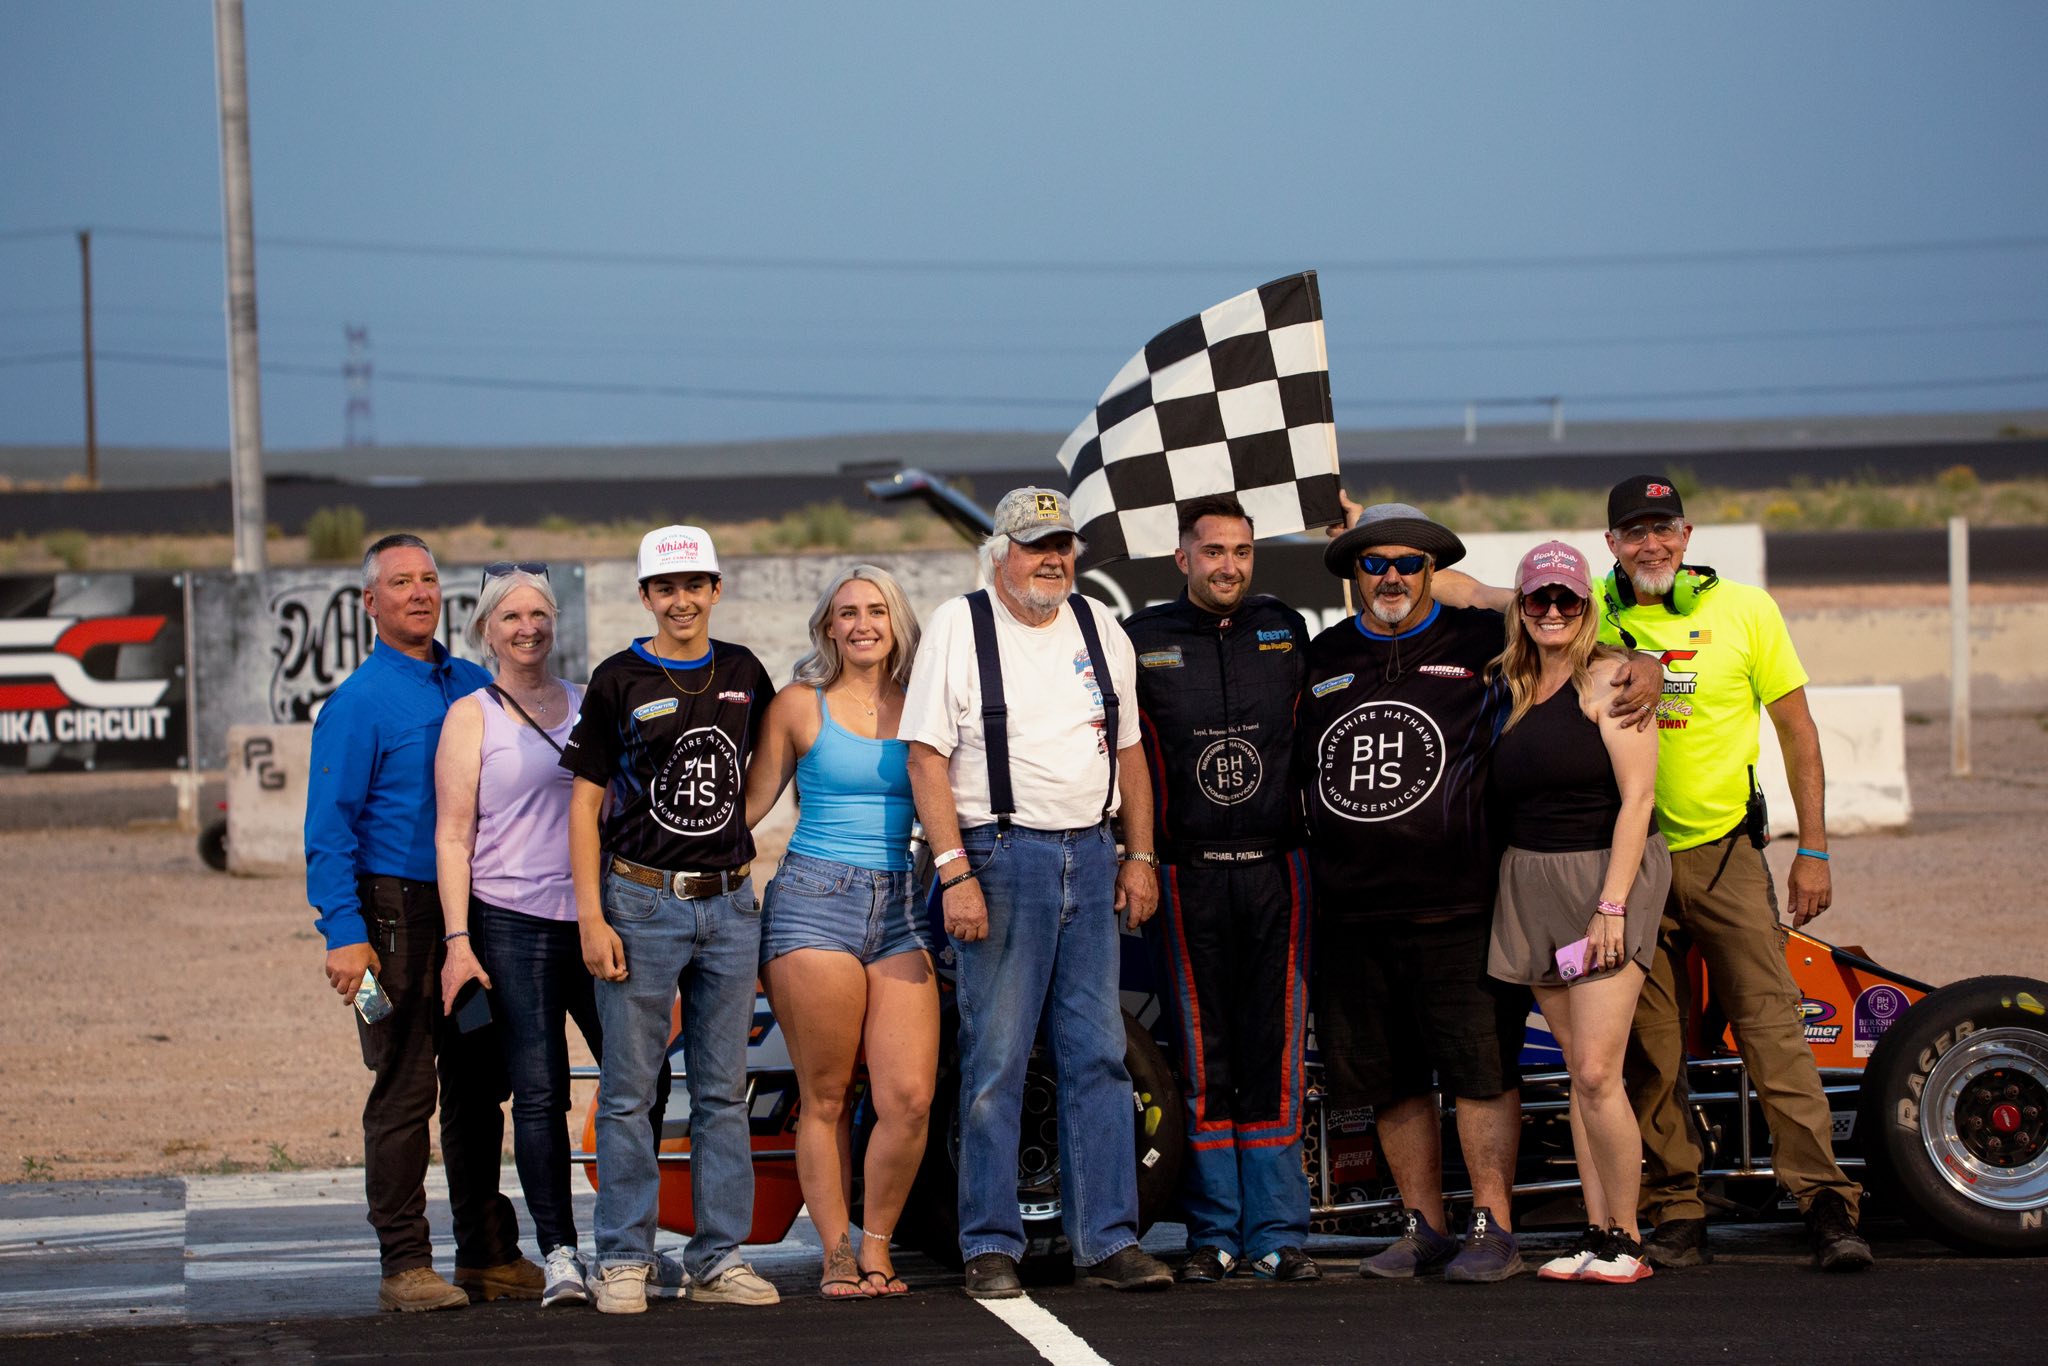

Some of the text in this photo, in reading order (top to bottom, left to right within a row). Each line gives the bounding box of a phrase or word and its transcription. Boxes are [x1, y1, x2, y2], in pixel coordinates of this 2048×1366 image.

[656, 540, 698, 554] Whiskey
[1419, 665, 1466, 674] RADICAL
[1663, 682, 1696, 693] IRCUIT
[54, 708, 171, 742] CIRCUIT
[1325, 710, 1435, 769] BERKSHIRE HATHAWAY
[1352, 731, 1403, 762] BH
[660, 737, 701, 791] BERKSHIRE
[1201, 741, 1258, 771] BERKSHIRE HATHAWAY
[1216, 755, 1243, 773] BH
[1217, 771, 1244, 789] HS
[1350, 762, 1402, 791] HS
[674, 781, 716, 806] HS
[1206, 780, 1255, 801] HOMESERVICES
[1328, 779, 1426, 812] HOMESERVICES
[657, 799, 732, 827] HOMESERVICES
[1203, 850, 1235, 860] MICHAEL
[1876, 996, 1889, 1004] BH
[1876, 1003, 1889, 1011] HS
[1858, 1018, 1896, 1026] BERKSH
[1897, 1020, 1976, 1133] RACER
[1328, 1114, 1374, 1129] SHOWDOW
[1335, 1157, 1373, 1169] SPORT
[1338, 1150, 1373, 1161] SPEED
